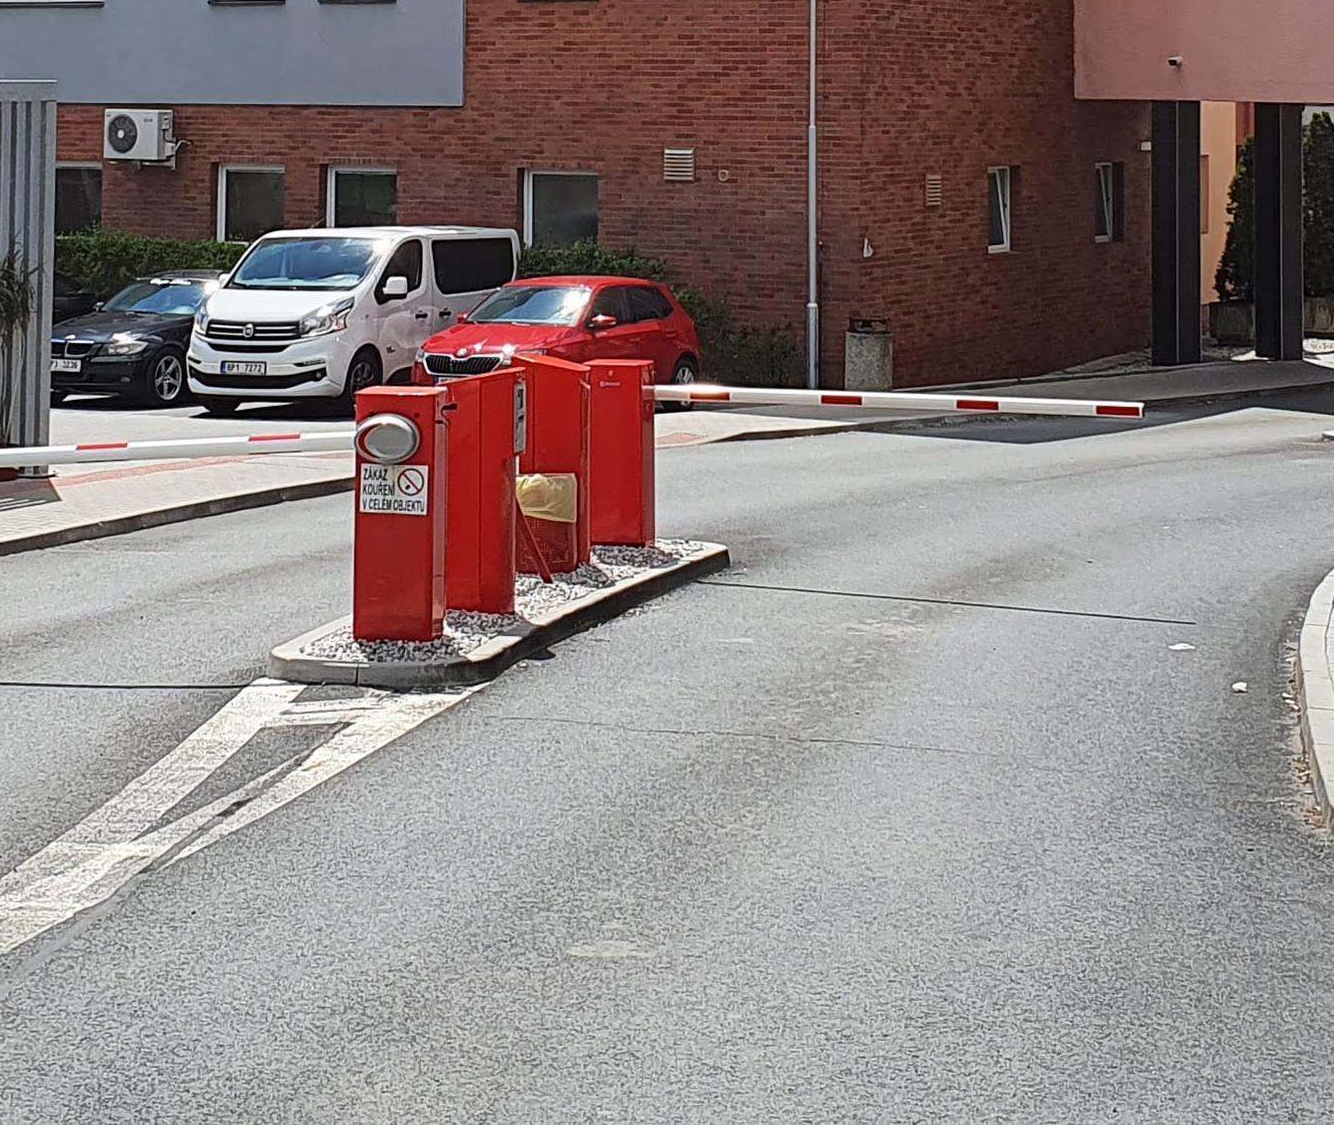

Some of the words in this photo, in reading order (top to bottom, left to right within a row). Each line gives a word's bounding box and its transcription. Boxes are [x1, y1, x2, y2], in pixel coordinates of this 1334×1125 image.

[363, 466, 388, 481] ZÁKAZ
[362, 481, 396, 496] KOUŘENÍ
[368, 498, 393, 511] CELÉM
[393, 499, 425, 512] OBJEKTU
